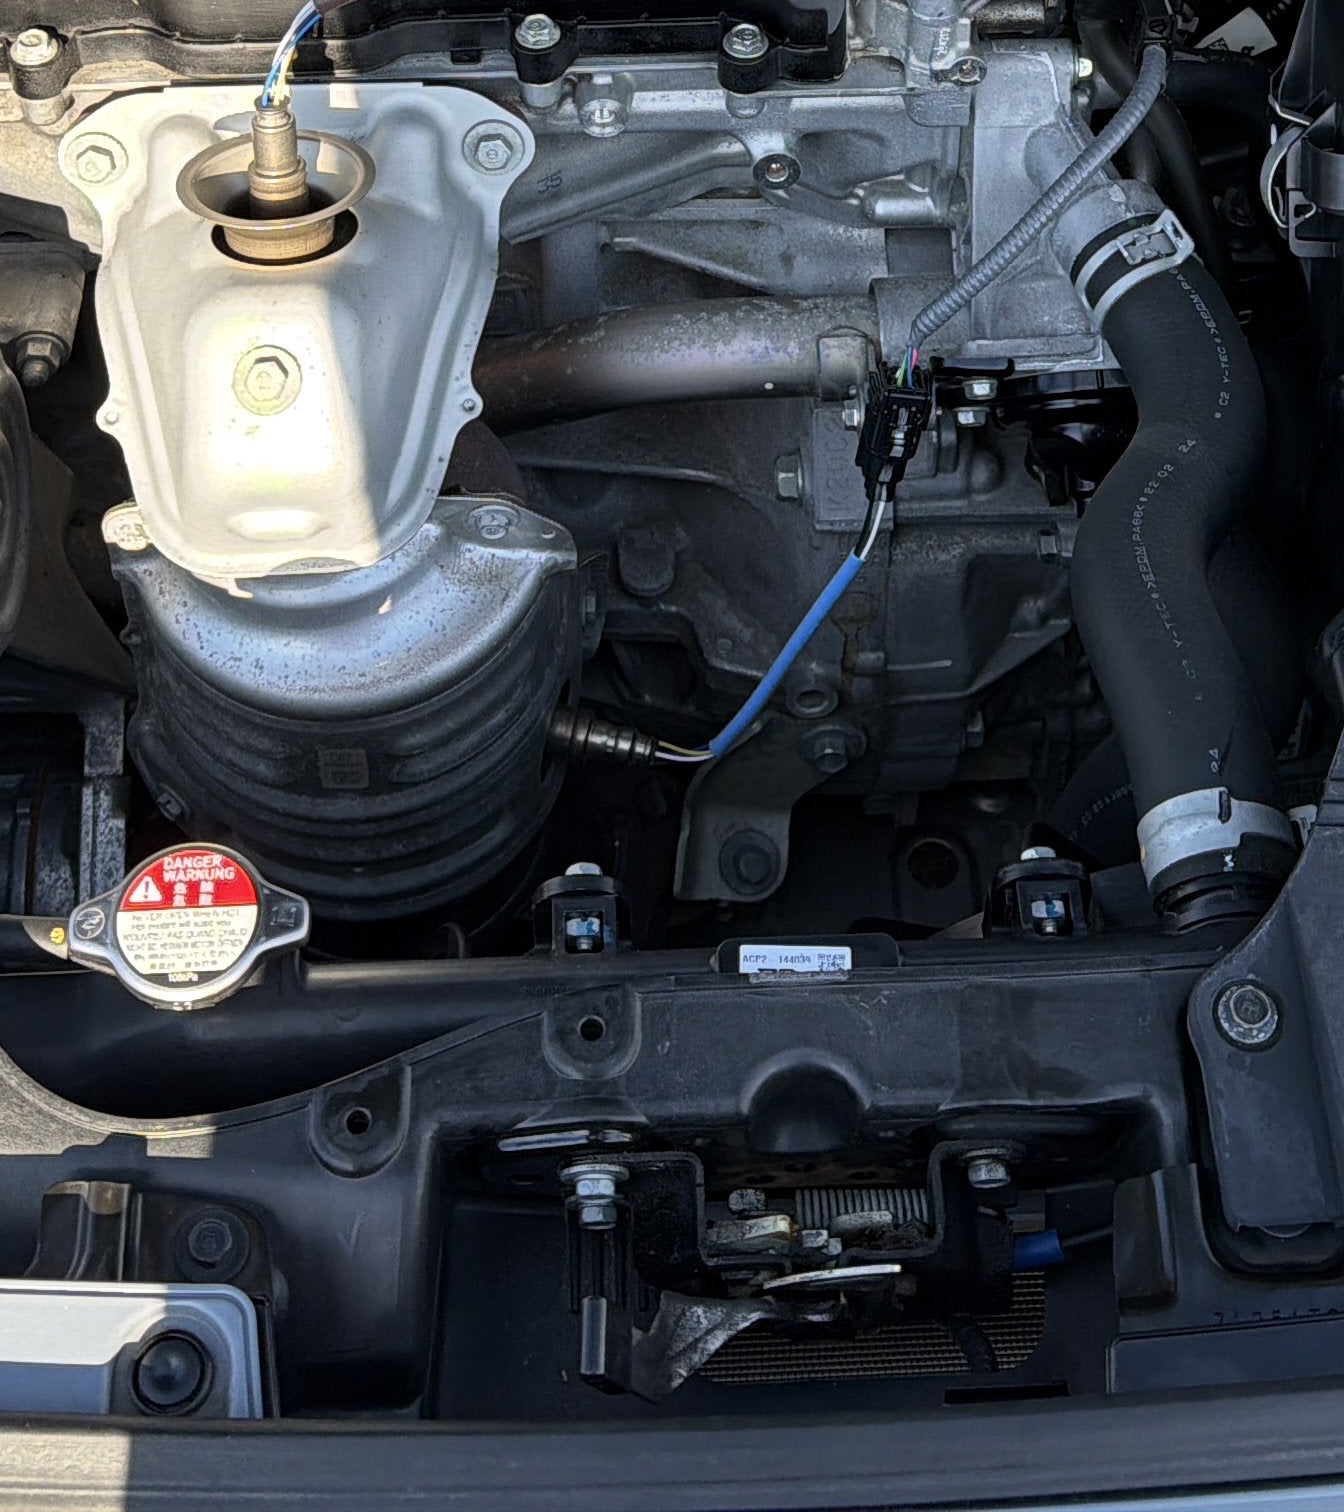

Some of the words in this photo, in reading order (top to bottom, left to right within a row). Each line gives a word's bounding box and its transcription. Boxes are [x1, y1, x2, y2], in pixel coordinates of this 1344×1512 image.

[1216, 345, 1232, 384] Y-TEC
[1217, 390, 1230, 407] C2
[163, 854, 223, 869] DANGER
[162, 866, 235, 882] WARNUNG
